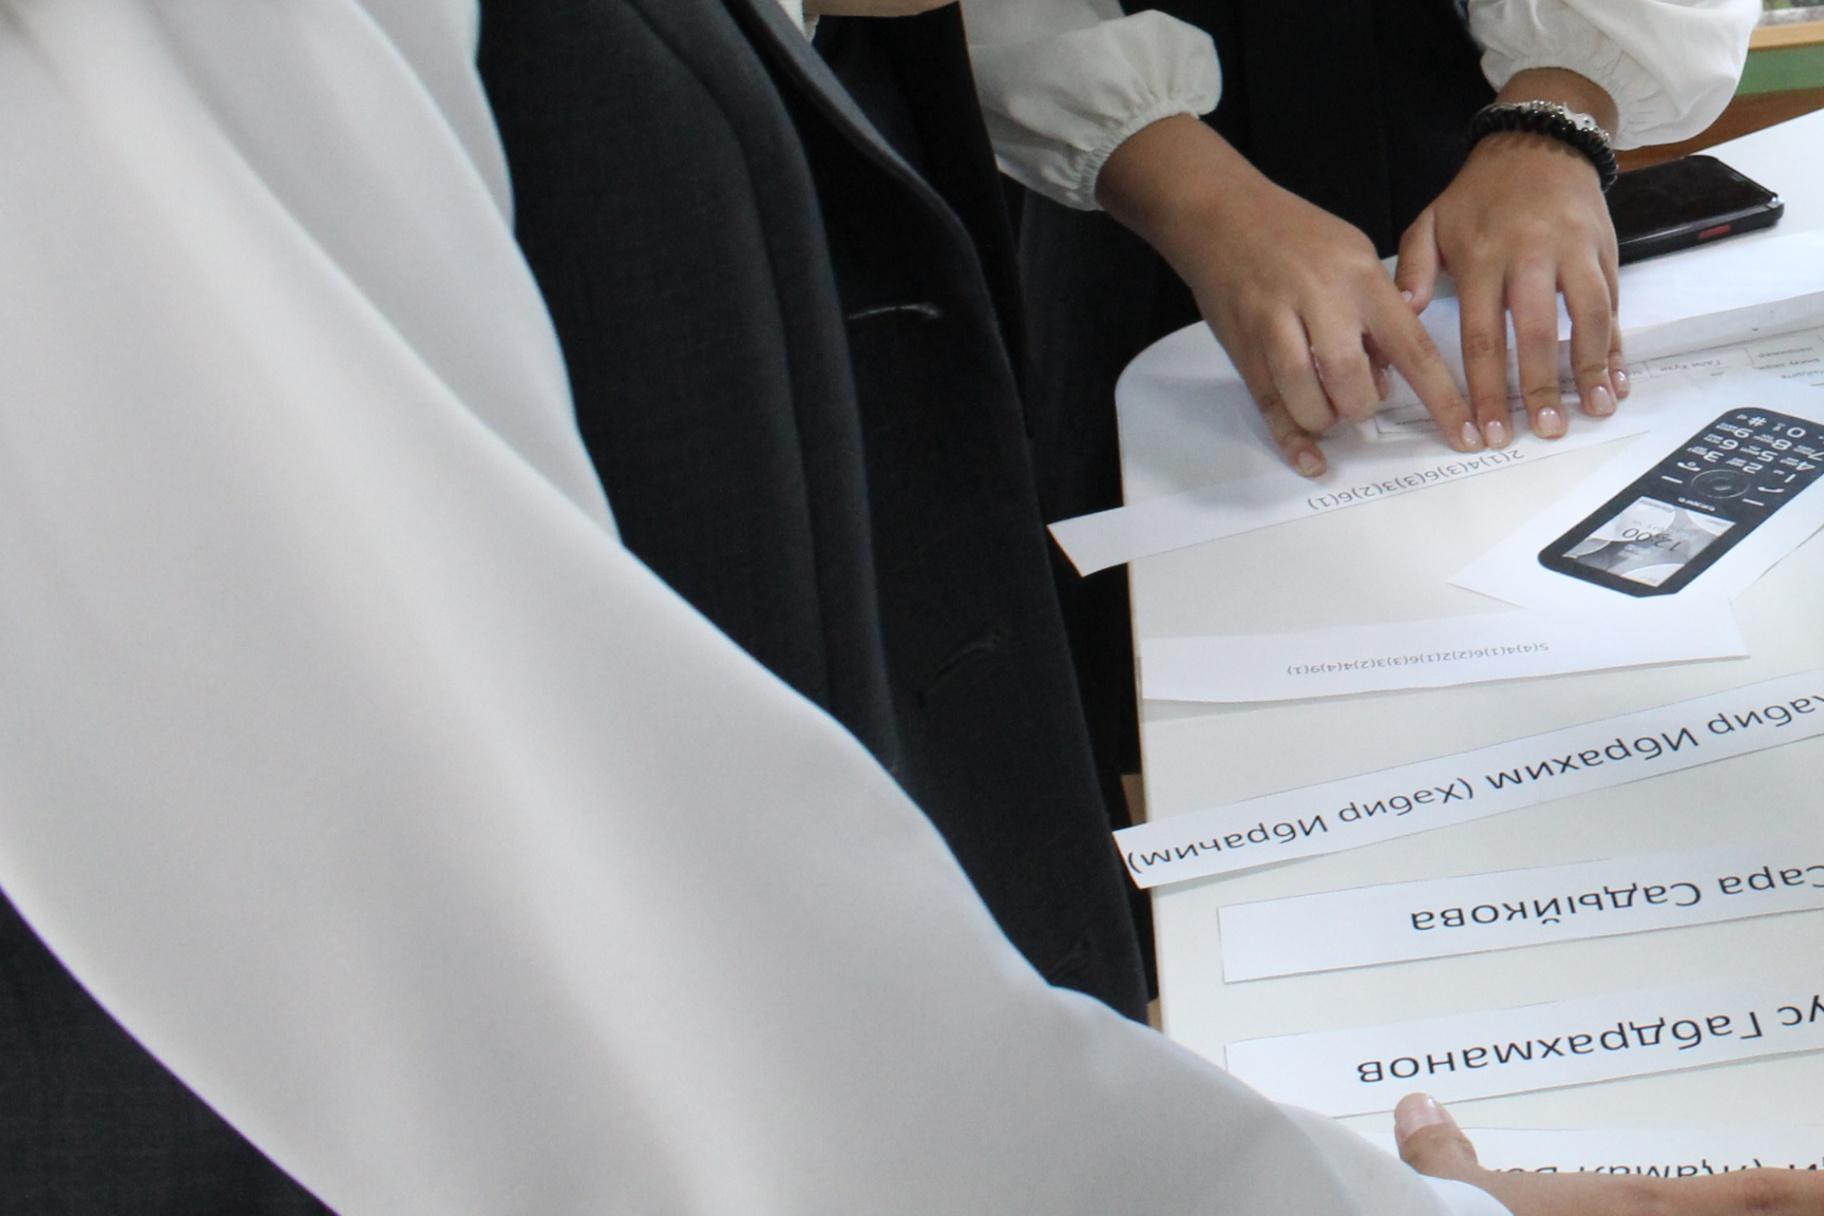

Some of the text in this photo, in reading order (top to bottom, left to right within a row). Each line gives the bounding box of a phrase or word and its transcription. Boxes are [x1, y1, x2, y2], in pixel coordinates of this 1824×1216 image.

[1733, 427, 1753, 439] 9
[1718, 439, 1739, 450] 6
[1771, 439, 1792, 451] 8
[1703, 450, 1724, 463] 3
[1757, 450, 1778, 462] 5
[1742, 462, 1763, 474] 2
[1795, 461, 1816, 471] 4
[1307, 449, 1524, 510] 2(1)4(3)6(3)3(2)6(1)
[1486, 725, 1699, 794] Ибрахим
[1338, 776, 1473, 828] (Хәбир
[1126, 812, 1327, 875] Ибраһим)
[1410, 882, 1702, 933] Садыйкова
[1356, 1010, 1763, 1085] Габдрахманов
